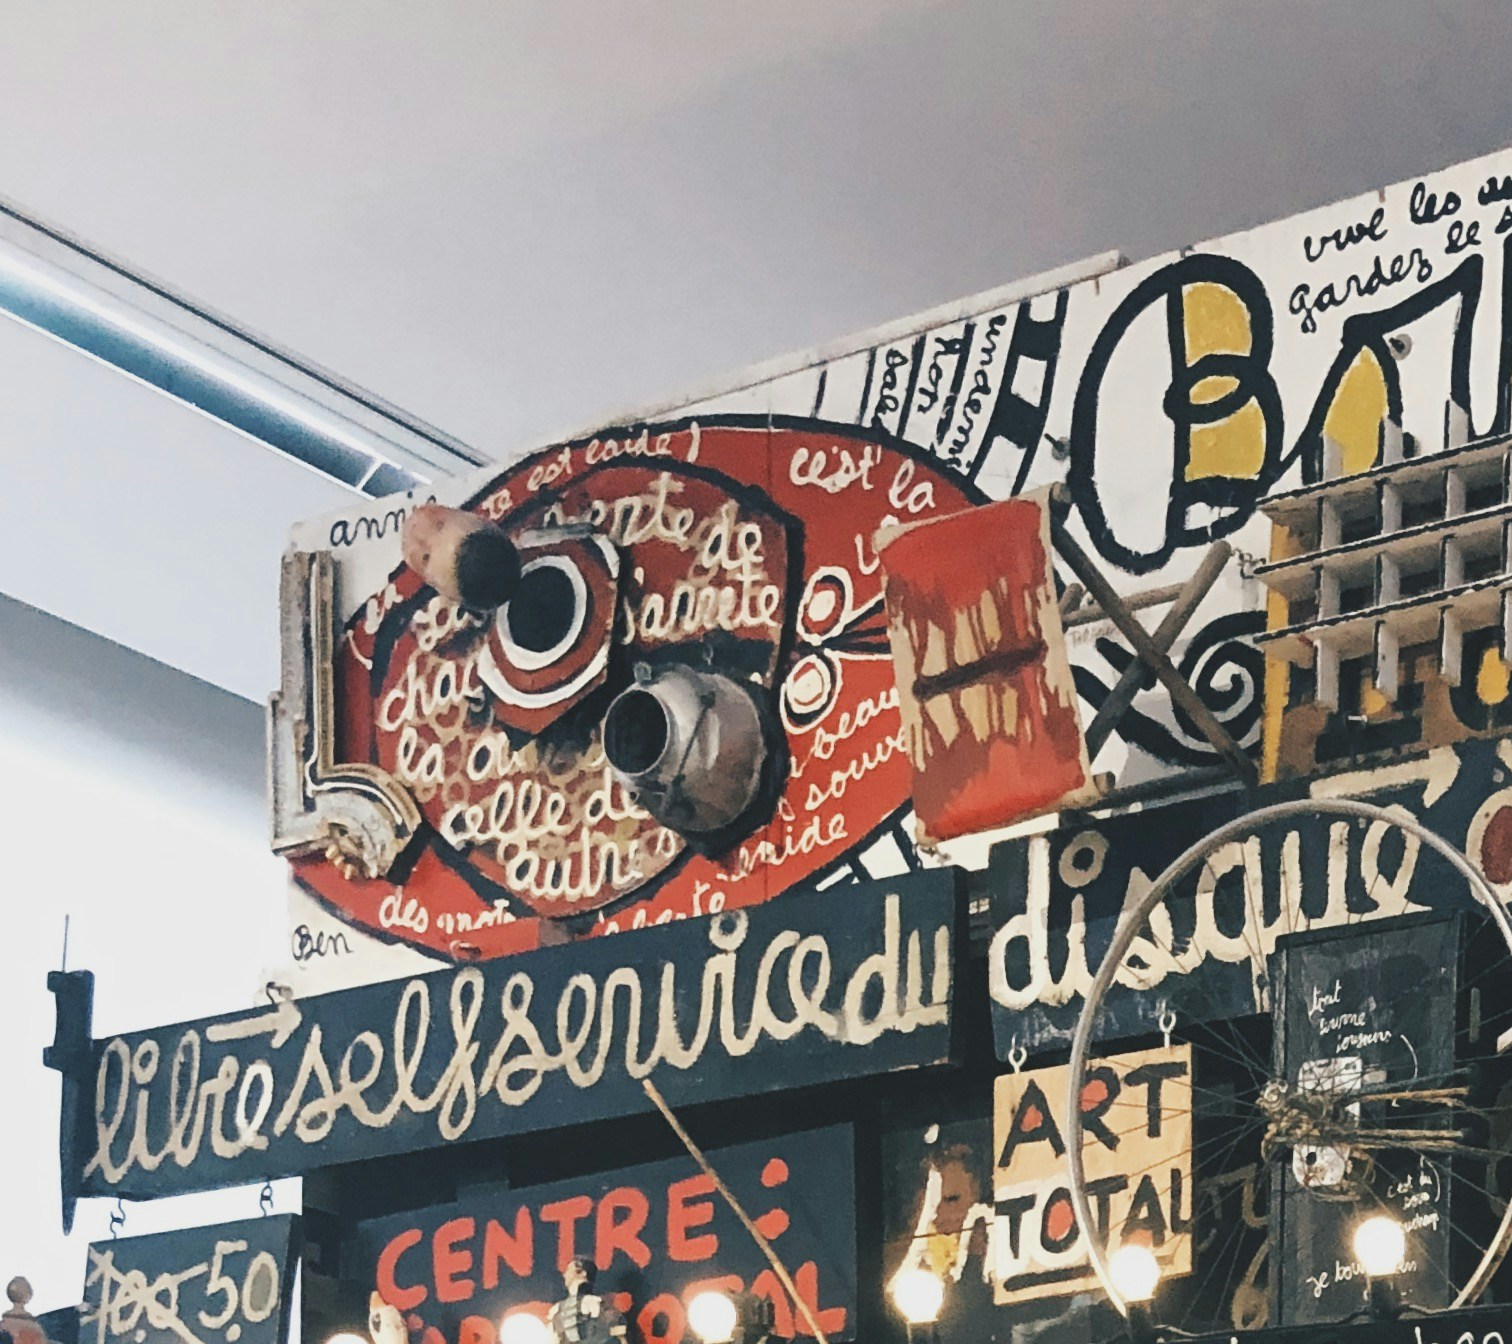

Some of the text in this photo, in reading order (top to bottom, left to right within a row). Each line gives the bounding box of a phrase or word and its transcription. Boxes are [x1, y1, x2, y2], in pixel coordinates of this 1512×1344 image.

[1409, 182, 1460, 222] les
[1288, 250, 1434, 335] gardez
[441, 775, 574, 850] celle
[996, 1060, 1189, 1168] ART
[996, 1166, 1194, 1262] TOTAL
